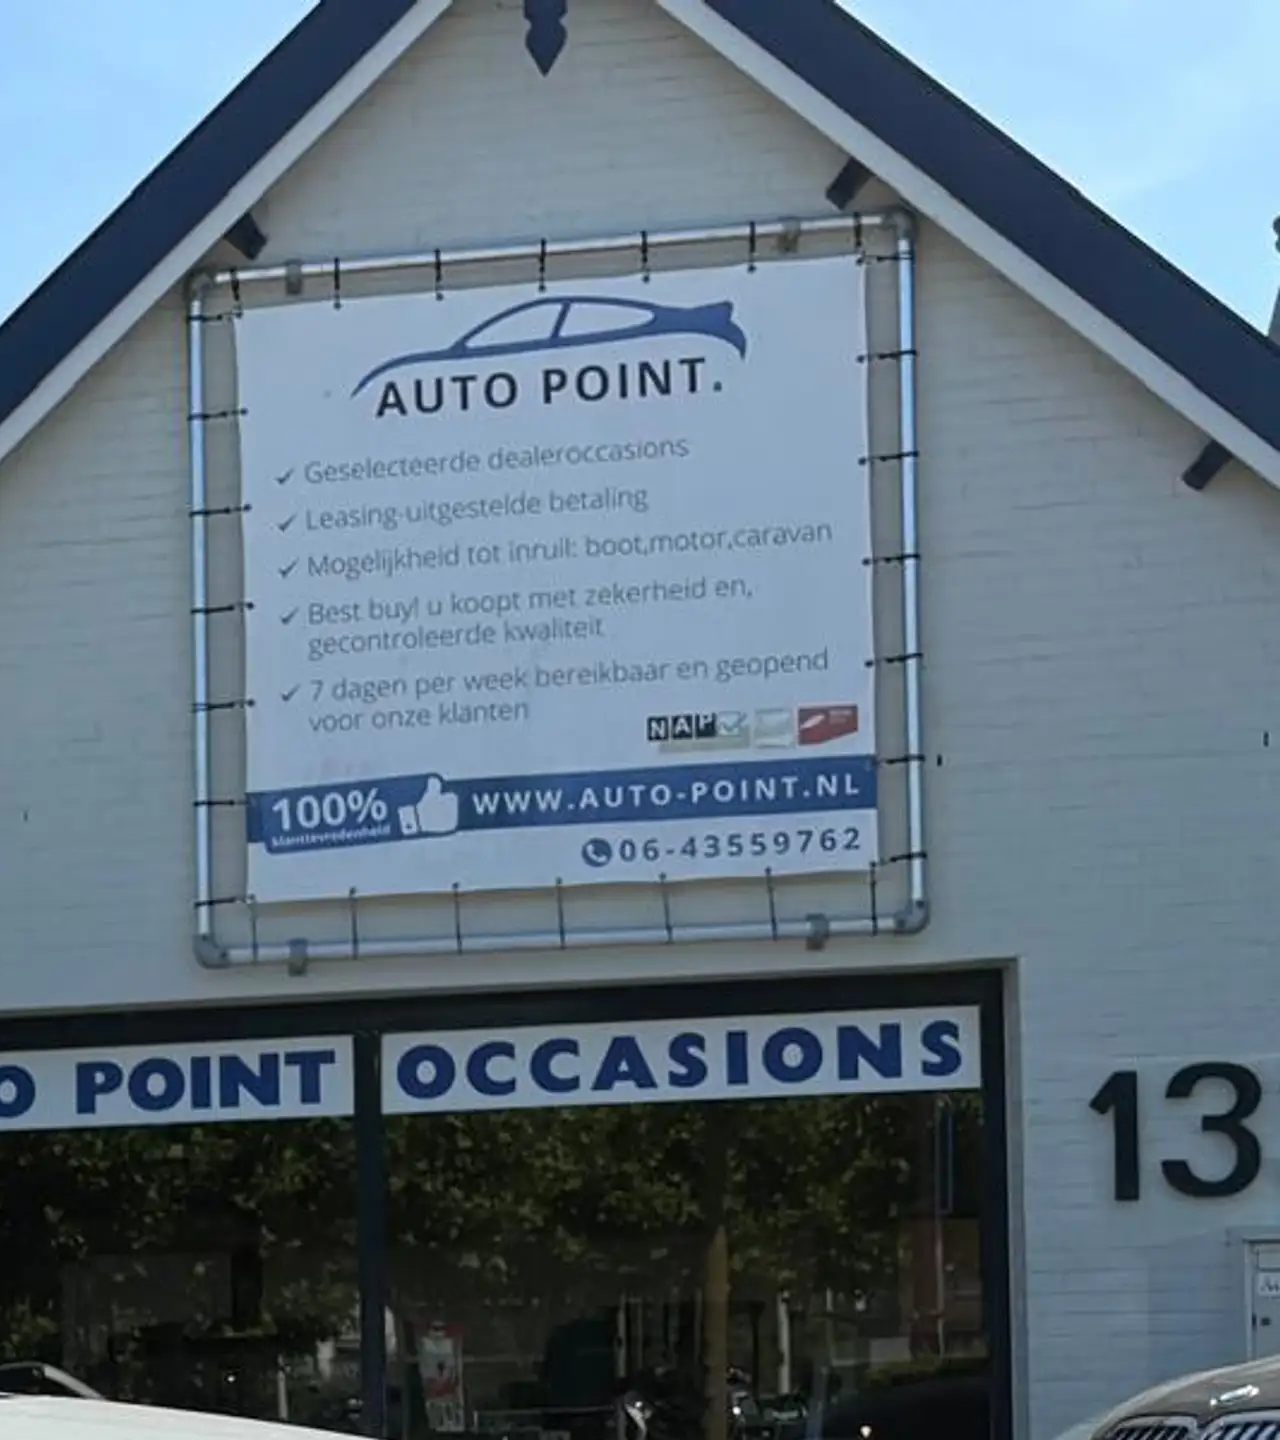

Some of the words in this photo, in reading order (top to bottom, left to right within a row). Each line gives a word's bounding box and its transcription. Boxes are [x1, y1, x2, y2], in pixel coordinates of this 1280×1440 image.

[375, 371, 519, 418] AUTO
[303, 450, 481, 484] Geselecteerde
[487, 438, 691, 471] dealeroccasions
[548, 487, 650, 514] betaling
[307, 544, 460, 581] Mogelijkheid
[468, 545, 501, 565] tot
[508, 537, 578, 562] inruil:
[585, 522, 833, 558] boot,motor,caravan
[308, 600, 363, 625] Best
[427, 600, 444, 616] u
[450, 592, 522, 617] koopt
[528, 588, 577, 610] met
[584, 577, 707, 606] zekerheid
[308, 622, 497, 662] gecontroleerde
[503, 616, 605, 643] kwaliteit
[309, 680, 325, 701] 7
[331, 674, 408, 704] dagen
[414, 675, 457, 699] per
[463, 667, 529, 690] week
[534, 660, 673, 688] bereikbaar
[675, 658, 709, 681] en
[713, 645, 831, 683] geopend
[308, 711, 365, 733] voor
[371, 707, 432, 729] onze
[439, 700, 531, 725] klanten
[647, 713, 717, 741] NAP
[271, 787, 389, 833] 100%
[472, 773, 861, 816] WWW.AUTO-POINT.NL
[618, 827, 861, 862] 06-43559762
[75, 1048, 337, 1115] POINT
[396, 1018, 964, 1100] OCCASIONS
[1088, 1061, 1262, 1201] 13
